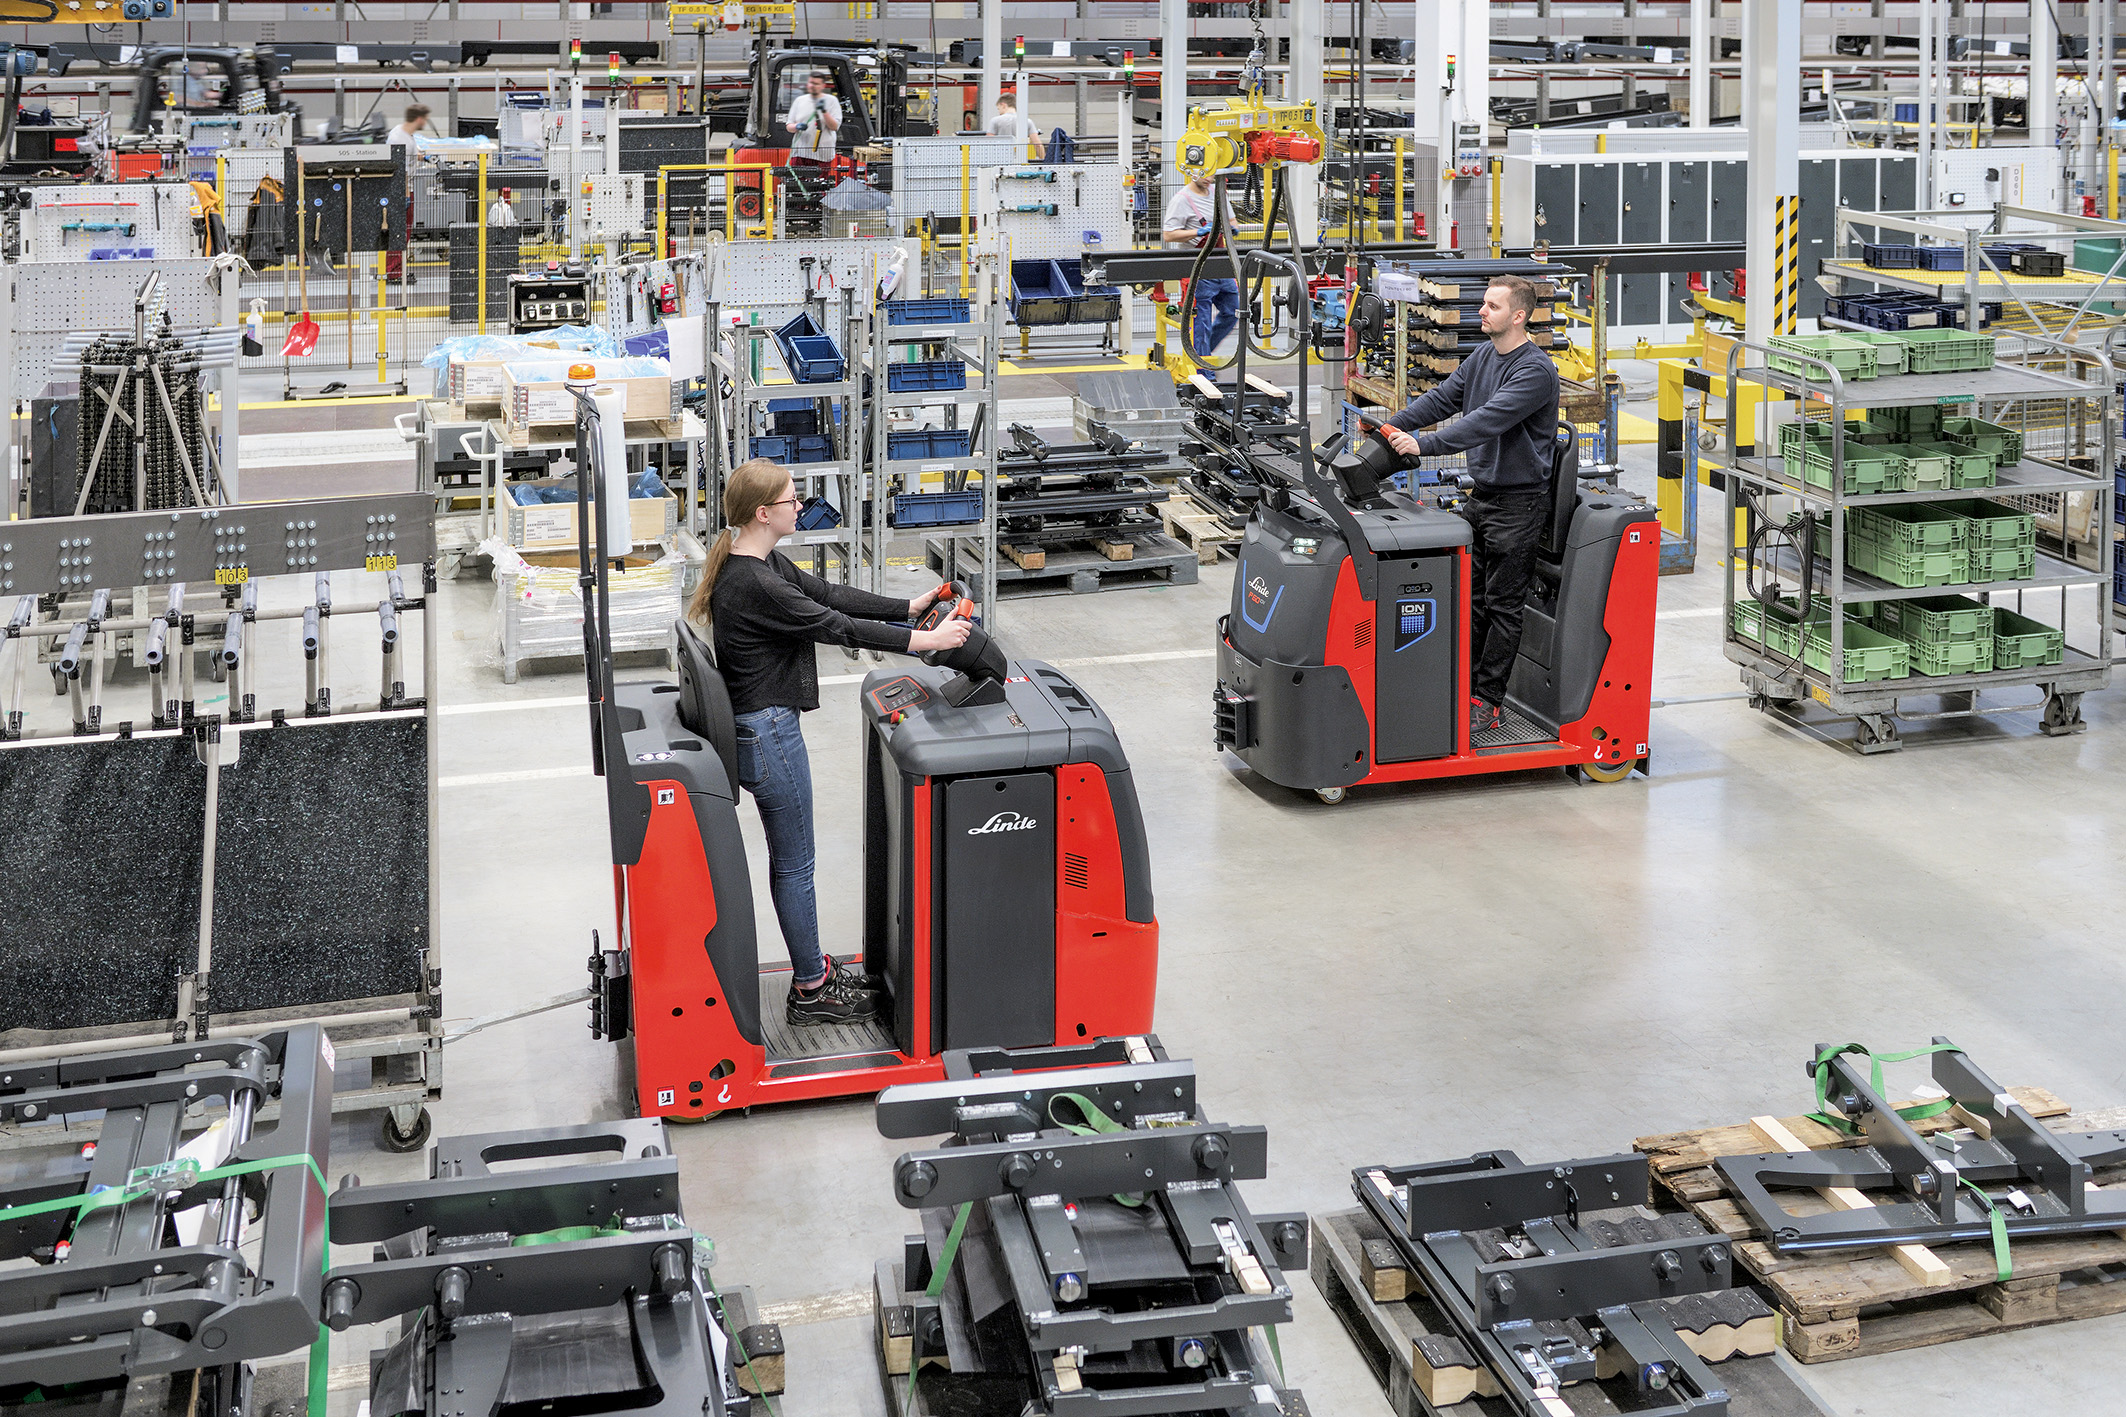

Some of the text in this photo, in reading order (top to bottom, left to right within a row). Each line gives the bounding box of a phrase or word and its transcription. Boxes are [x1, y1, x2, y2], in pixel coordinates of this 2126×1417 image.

[1280, 111, 1288, 122] TF
[369, 559, 396, 570] 113
[218, 571, 247, 583] 103
[1247, 576, 1270, 598] Linde
[1401, 604, 1425, 613] ION
[967, 811, 1037, 835] Linde
